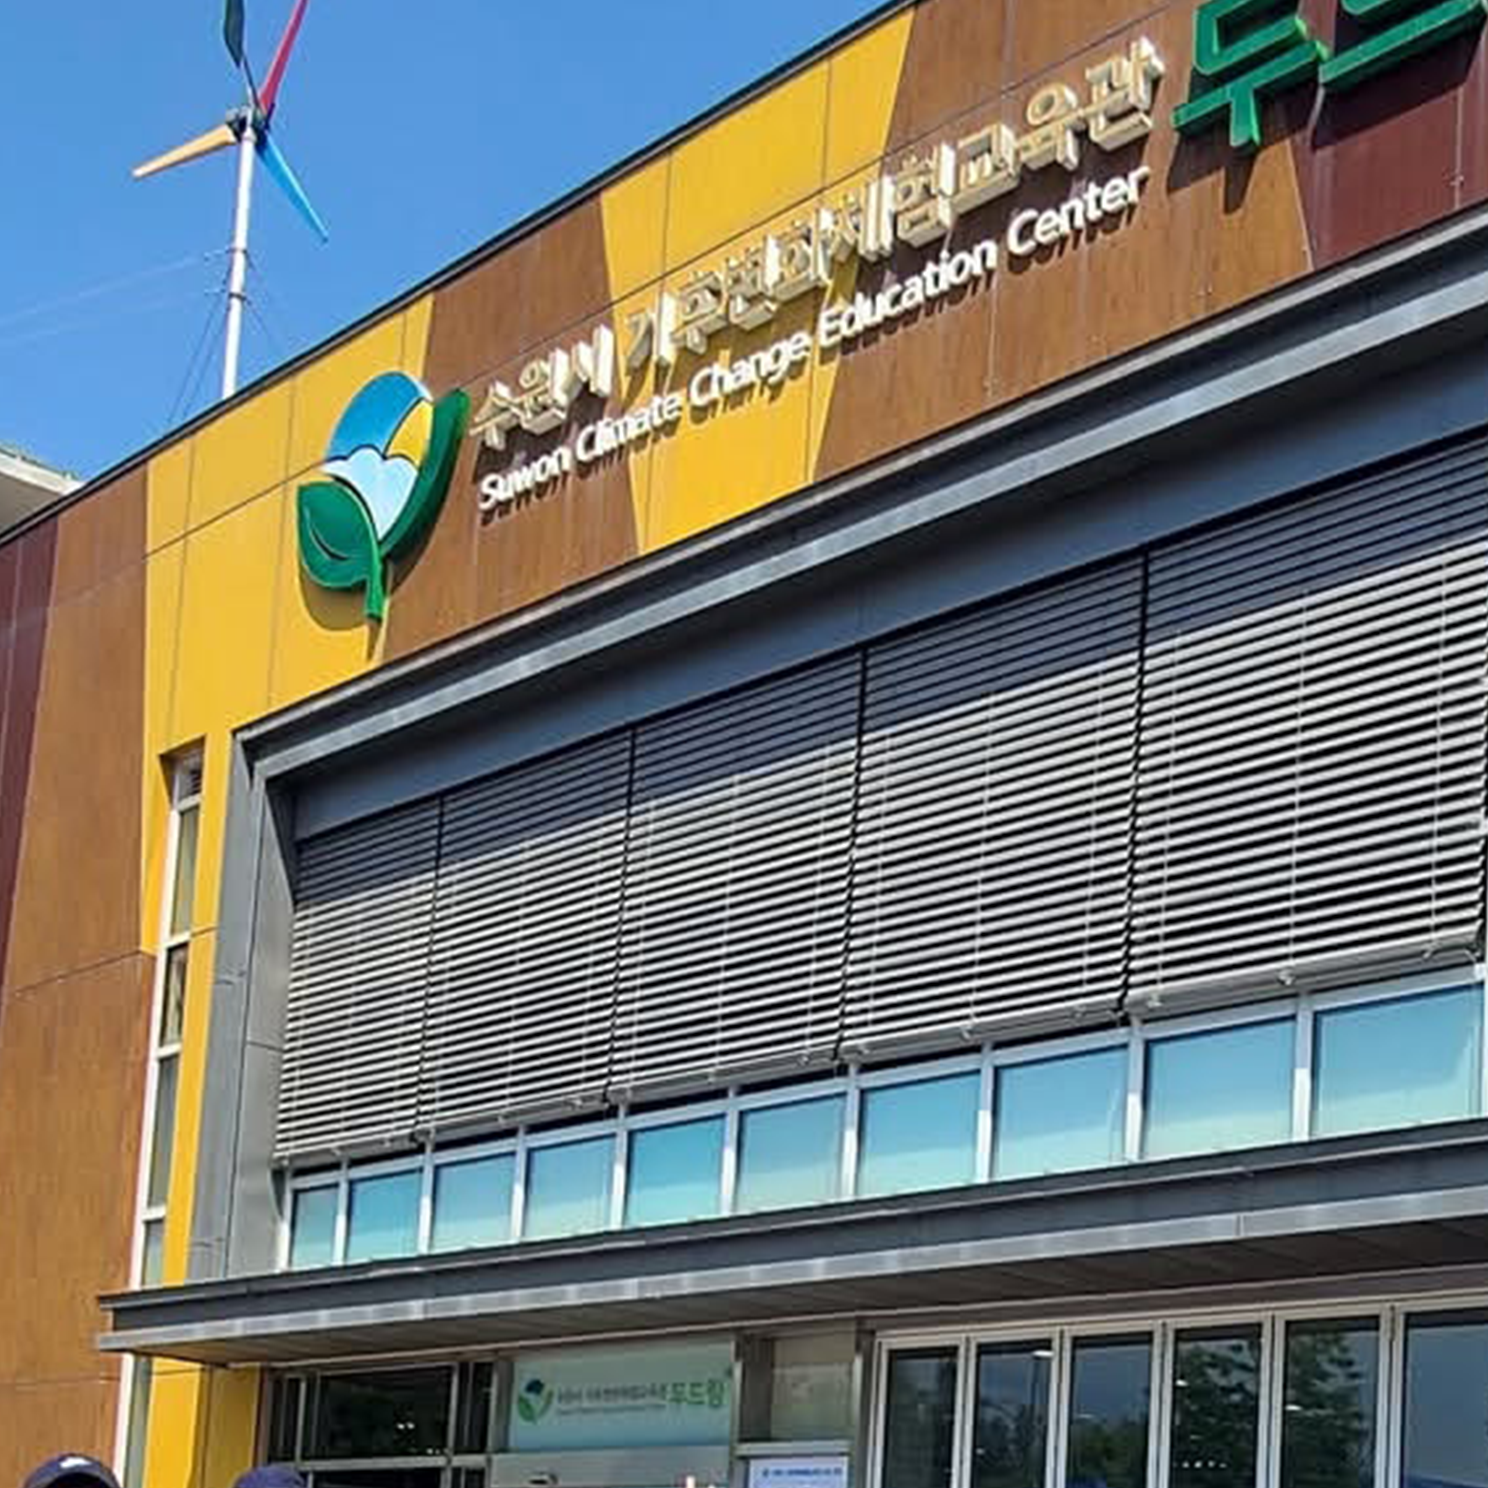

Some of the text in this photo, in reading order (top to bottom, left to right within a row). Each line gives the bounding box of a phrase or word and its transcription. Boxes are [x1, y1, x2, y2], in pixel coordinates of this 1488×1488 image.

[469, 324, 613, 450] 수원시
[478, 167, 1150, 510] Suwon Climate Change Education Center
